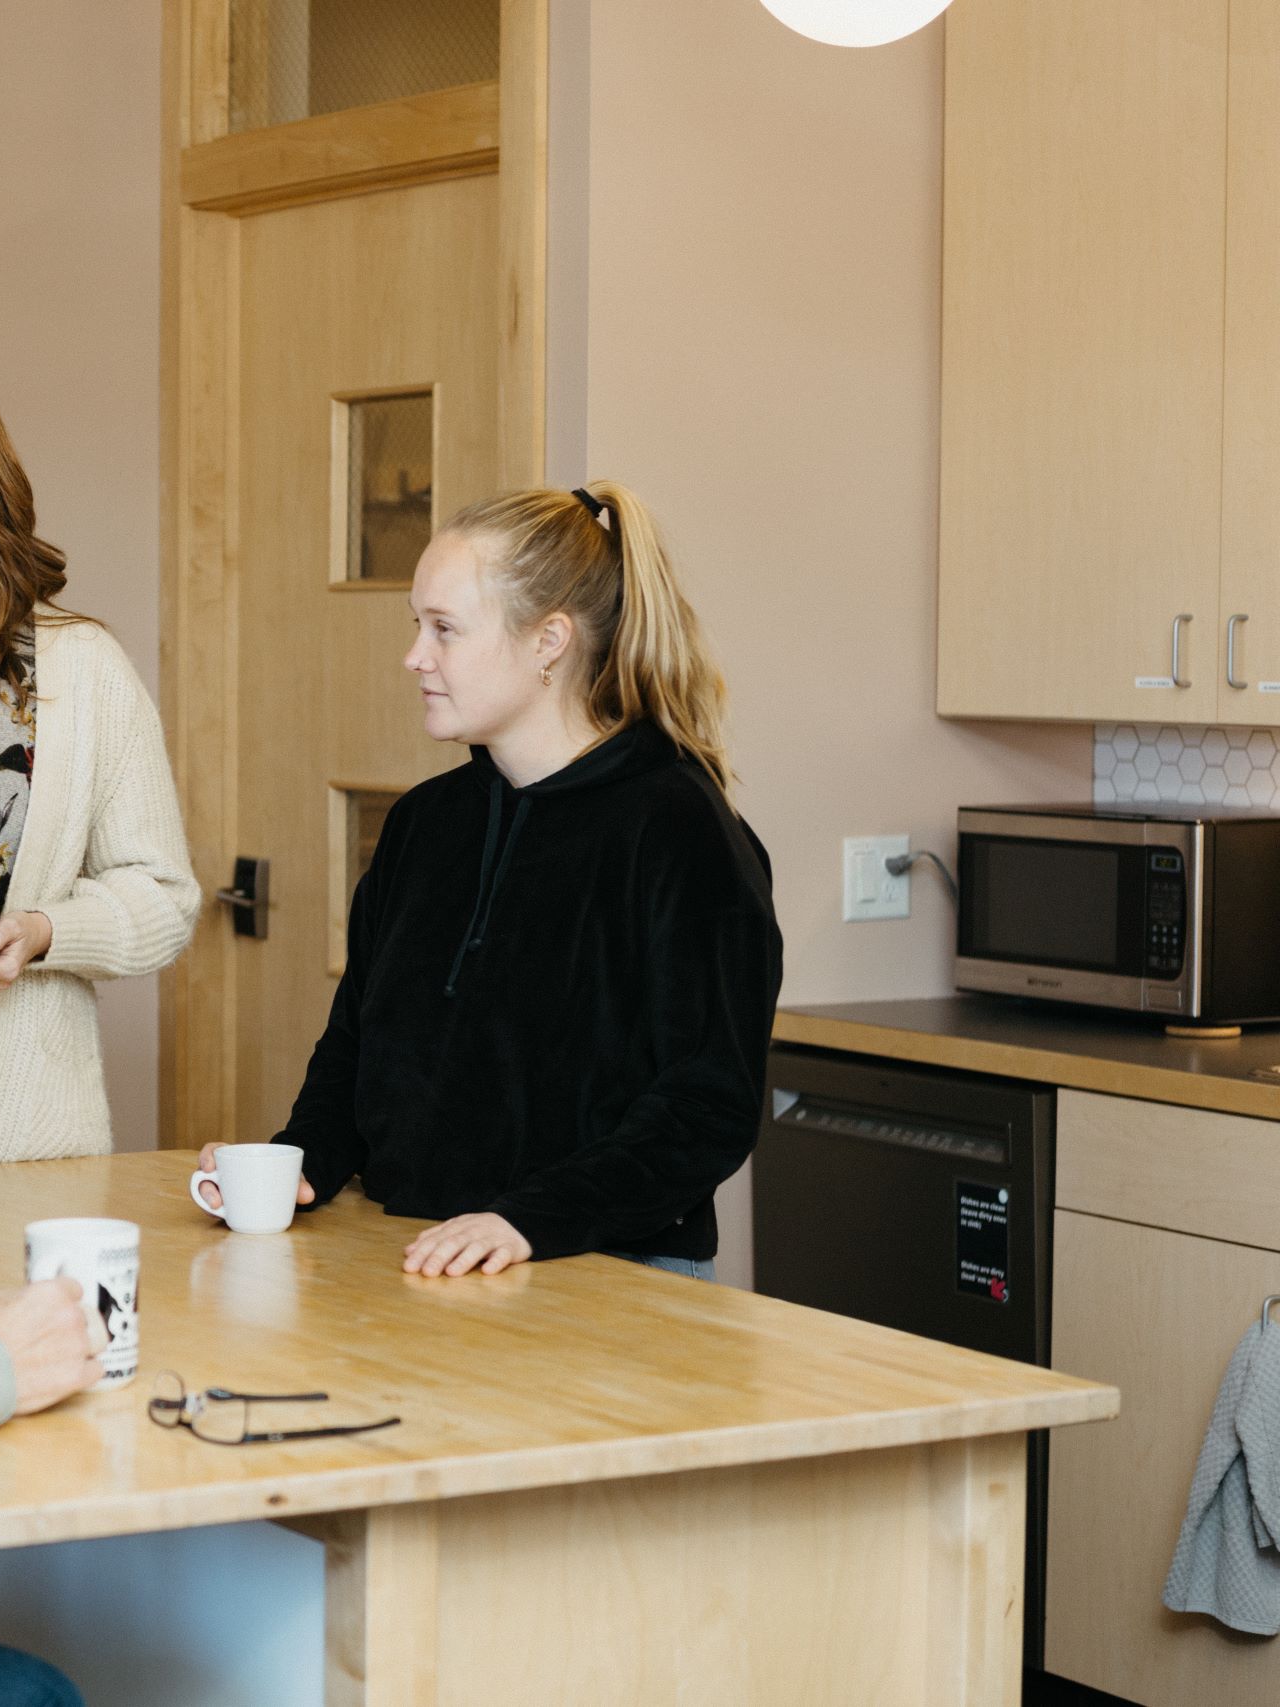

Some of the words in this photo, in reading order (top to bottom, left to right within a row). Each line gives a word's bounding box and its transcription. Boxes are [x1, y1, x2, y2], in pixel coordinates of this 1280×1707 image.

[961, 1196, 979, 1207] Dishes
[980, 1201, 989, 1209] are
[961, 1260, 979, 1272] Dishes
[980, 1266, 990, 1274] are
[990, 1268, 1004, 1279] dirty
